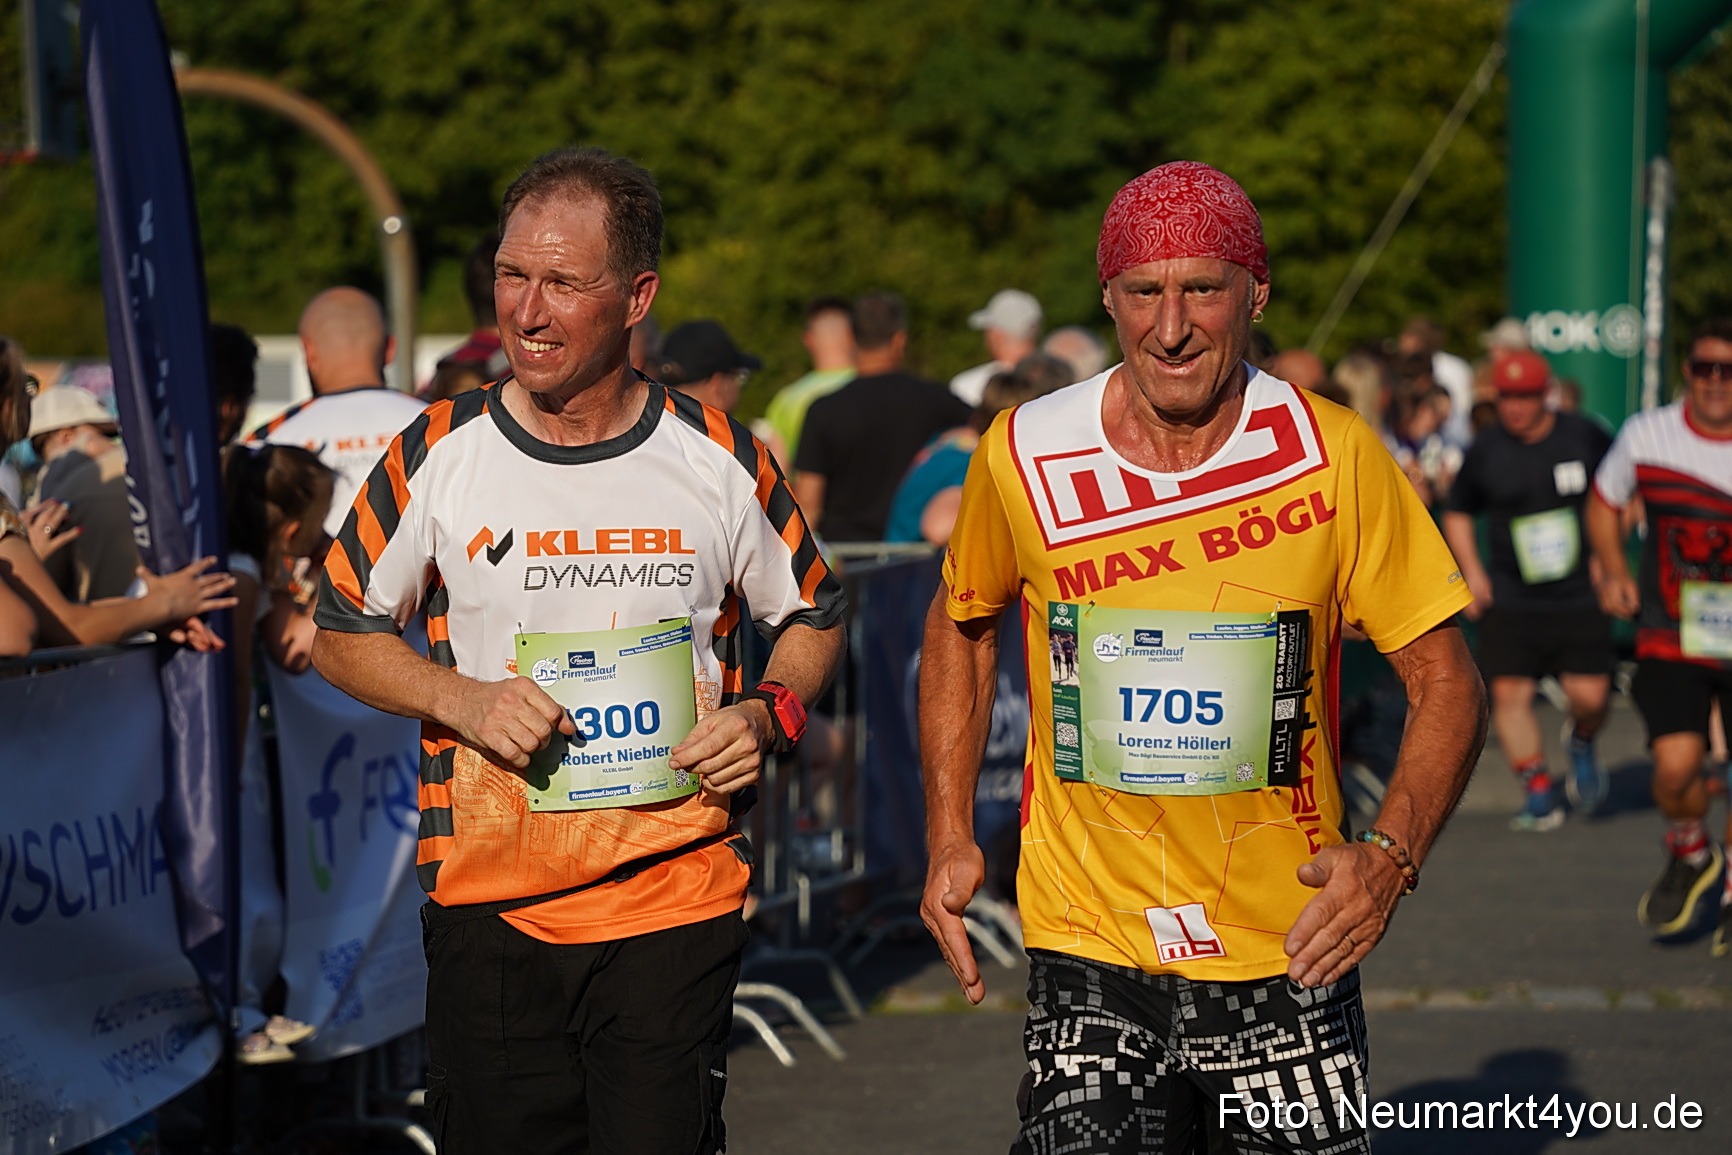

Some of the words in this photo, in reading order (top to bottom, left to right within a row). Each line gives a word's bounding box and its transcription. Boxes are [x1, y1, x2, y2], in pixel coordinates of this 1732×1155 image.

[526, 528, 696, 557] KLEBL
[1052, 539, 1186, 601] MAX
[1198, 491, 1337, 563] BÖGL
[524, 563, 695, 591] DYNAMICS
[1052, 615, 1074, 628] AOK
[1125, 646, 1184, 657] Firmenlauf
[1278, 623, 1288, 665] RABATT
[561, 664, 616, 679] Firmenlauf
[583, 673, 616, 683] neumarkt
[1285, 654, 1294, 688] FACTORY
[1276, 675, 1284, 689] 20
[1118, 687, 1224, 726] 1705
[1118, 733, 1173, 750] Lorenz
[1177, 735, 1232, 751] Höllerl
[1274, 723, 1288, 774] HILTL
[562, 750, 613, 766] Robert
[617, 745, 670, 763] Niebler
[1122, 774, 1182, 784] firmenlauf.bayern
[571, 788, 628, 800] firmenlauf.bayern
